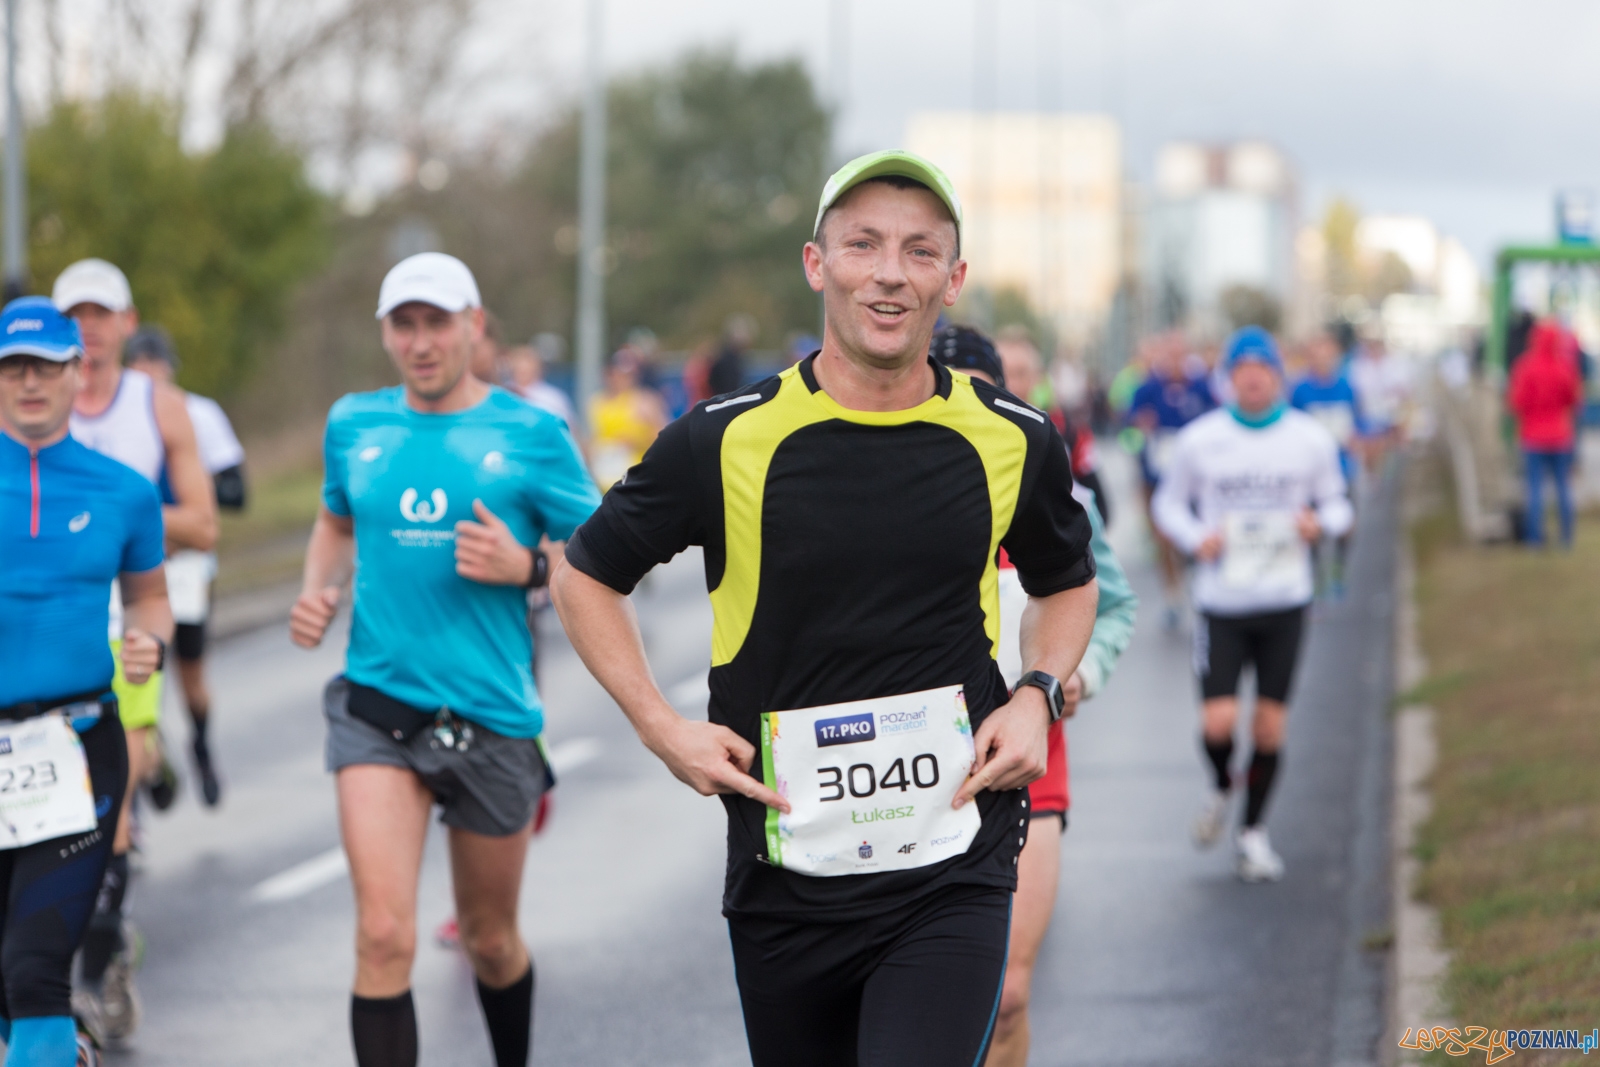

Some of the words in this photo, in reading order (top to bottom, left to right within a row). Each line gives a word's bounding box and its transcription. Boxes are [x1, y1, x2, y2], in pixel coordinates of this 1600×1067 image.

[881, 719, 928, 733] maraton
[817, 753, 940, 802] 3040
[851, 805, 915, 824] Łukasz
